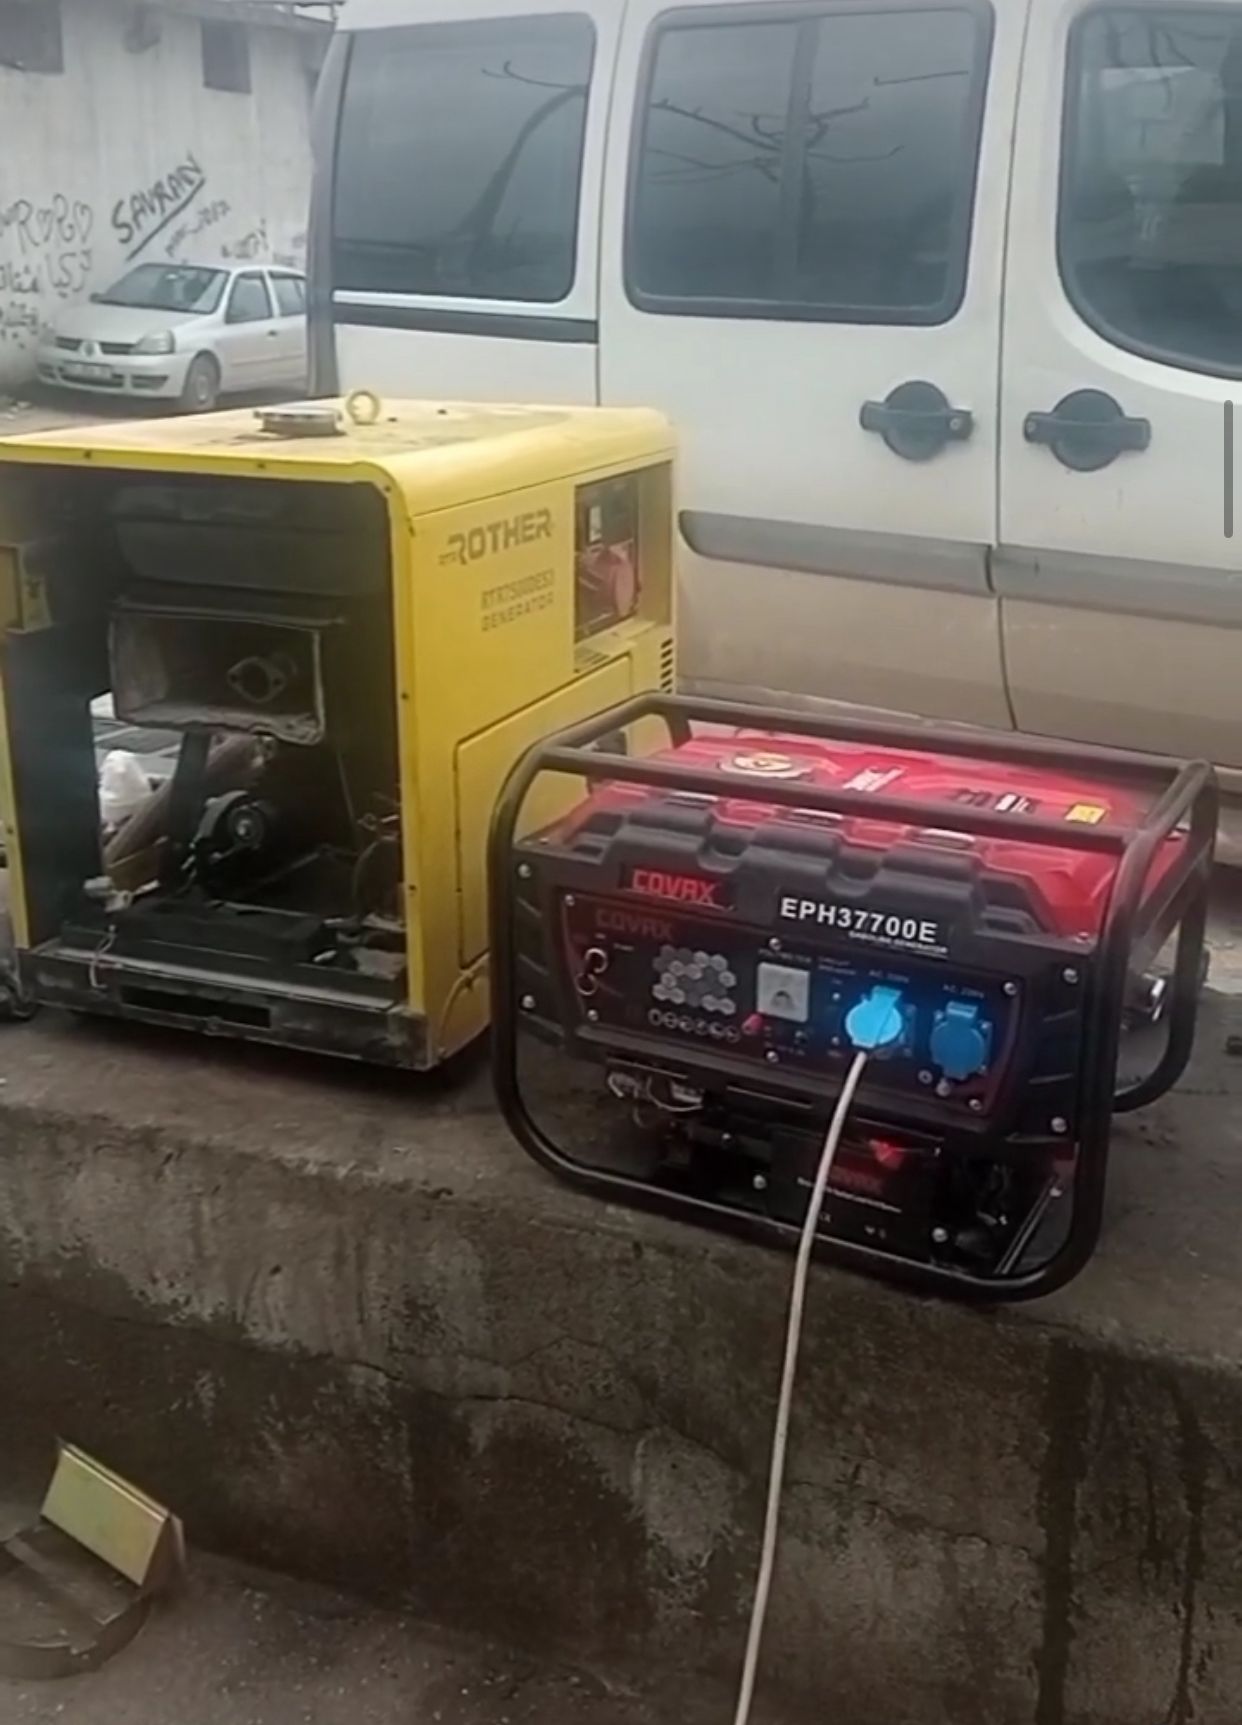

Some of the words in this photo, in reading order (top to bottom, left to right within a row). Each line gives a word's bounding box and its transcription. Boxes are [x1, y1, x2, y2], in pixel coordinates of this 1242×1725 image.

[446, 507, 553, 566] ROTHER
[632, 869, 716, 906] COVAX
[780, 897, 939, 944] EPH37700E
